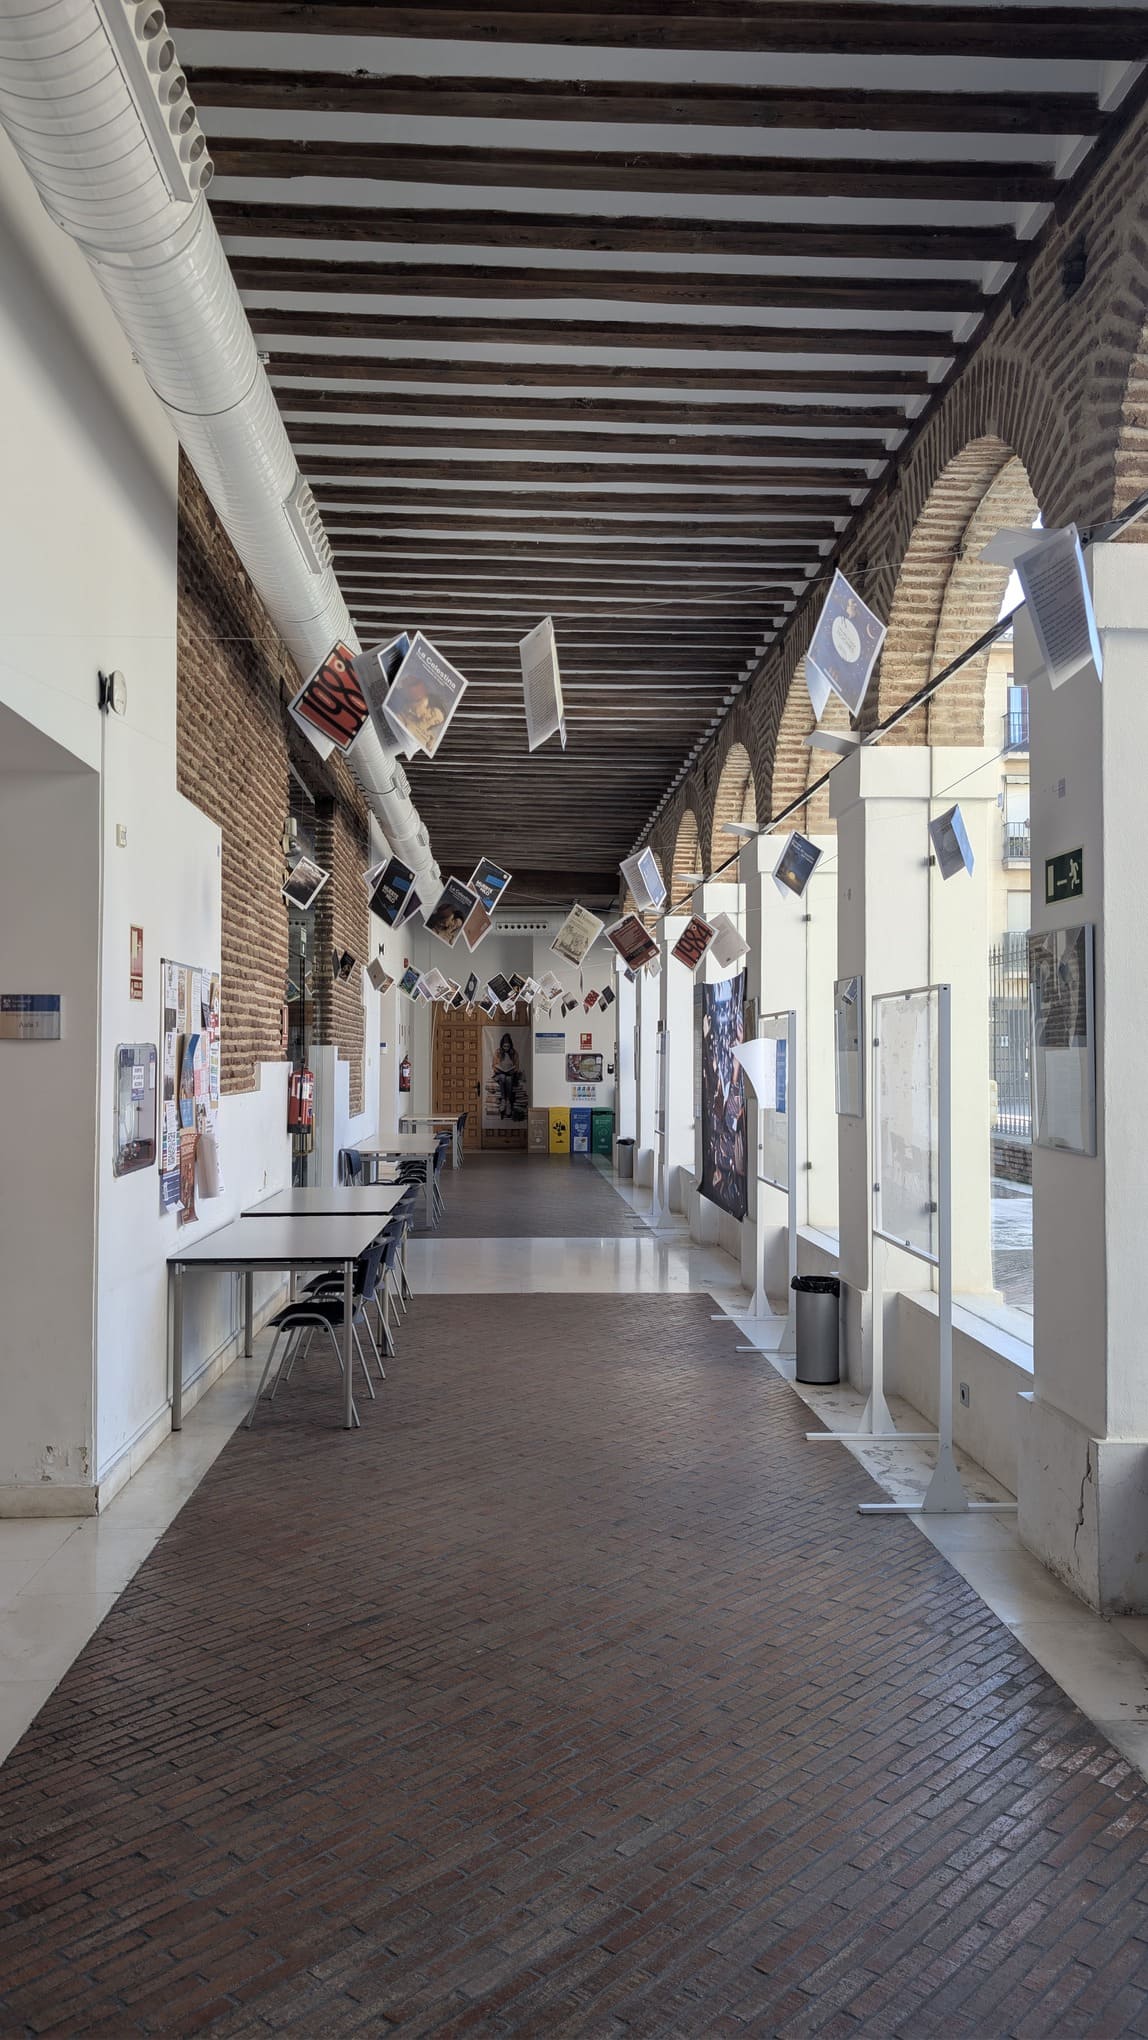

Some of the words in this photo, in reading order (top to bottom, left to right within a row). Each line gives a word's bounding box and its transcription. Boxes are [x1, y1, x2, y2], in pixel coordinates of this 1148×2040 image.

[416, 647, 427, 661] La
[425, 657, 457, 690] Celestina
[676, 919, 714, 965] 1984
